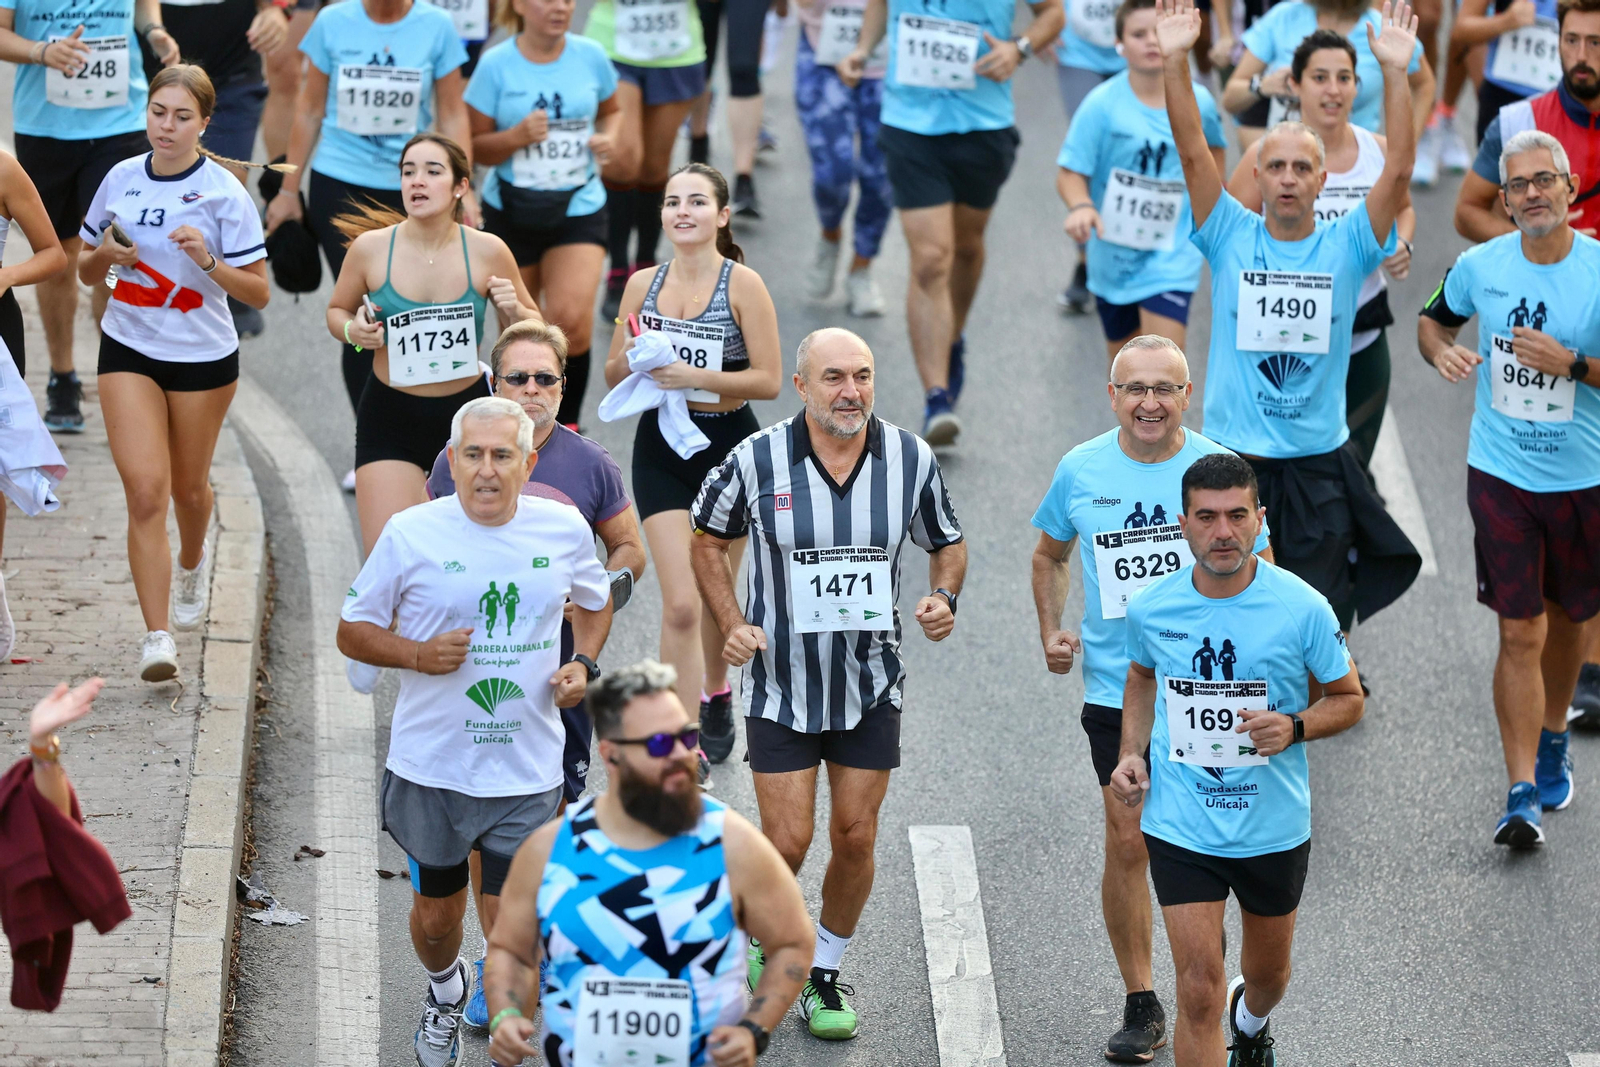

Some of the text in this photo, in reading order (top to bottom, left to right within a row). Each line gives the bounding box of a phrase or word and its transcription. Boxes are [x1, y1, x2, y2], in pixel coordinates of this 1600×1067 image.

[906, 38, 970, 64] 11626
[346, 88, 414, 108] 11820
[1114, 194, 1177, 222] 11628
[136, 208, 165, 227] 13
[1243, 272, 1267, 286] 43
[1256, 296, 1317, 320] 1490
[390, 305, 472, 329] 43 CARRERA URBANA
[642, 315, 723, 334] 43 CARRERA URBANA
[397, 327, 470, 355] 11734
[1494, 337, 1514, 354] 43
[672, 344, 707, 368] 98
[1503, 364, 1561, 391] 9647
[1257, 391, 1311, 405] Fundación
[1263, 407, 1302, 420] Unicaja
[1510, 427, 1567, 439] Fundación
[1519, 443, 1559, 455] Unicaja
[1096, 525, 1182, 549] 43 CARRERA URBA
[793, 550, 819, 565] 43
[1114, 551, 1181, 581] 6329
[810, 572, 873, 598] 1471
[1159, 630, 1188, 640] málaga
[467, 642, 542, 653] CARRERA URBANA
[1168, 679, 1194, 696] 43
[465, 719, 522, 729] Fundación
[473, 734, 513, 745] Unicaja
[1195, 782, 1258, 793] Fundación
[1205, 797, 1250, 811] Unicaja
[586, 981, 610, 995] 43
[587, 1009, 681, 1038] 11900
